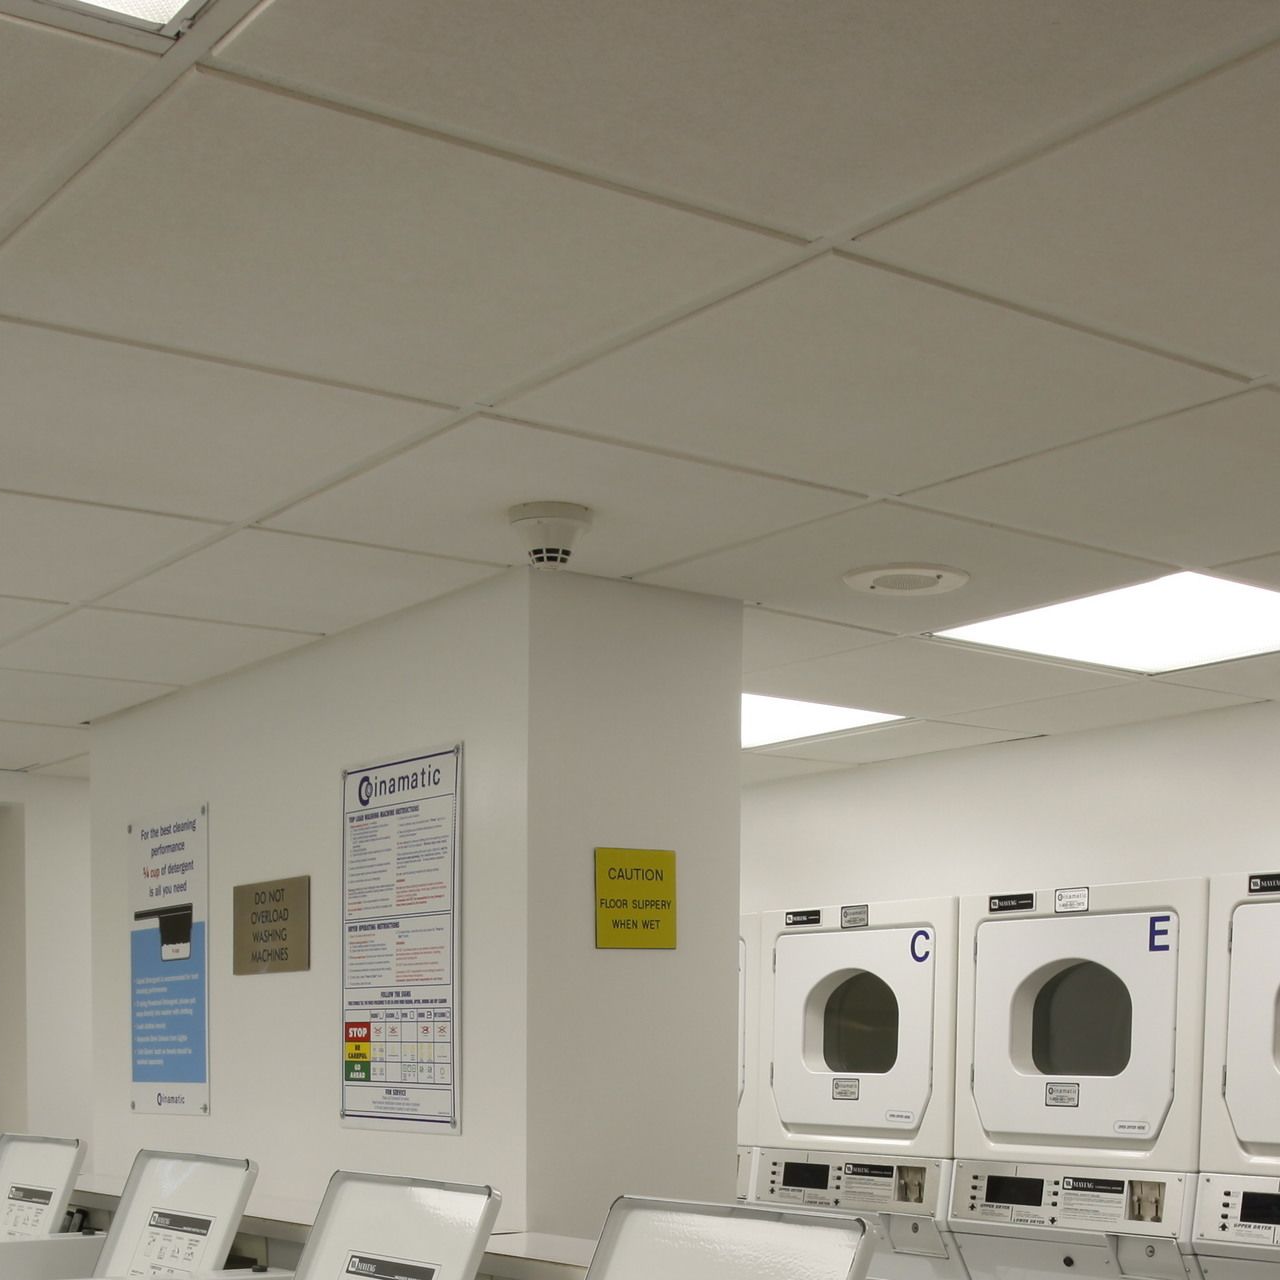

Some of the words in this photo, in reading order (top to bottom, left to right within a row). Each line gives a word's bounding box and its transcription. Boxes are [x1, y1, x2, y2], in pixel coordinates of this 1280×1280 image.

[172, 819, 196, 834] cleaning
[151, 841, 185, 858] performance
[167, 859, 194, 875] detergent
[608, 867, 664, 881] CAUTION
[173, 880, 187, 893] need
[254, 891, 267, 905] DO
[268, 888, 285, 903] NOT
[600, 898, 628, 909] FLOOR
[632, 900, 672, 910] SLIPPERY
[250, 907, 289, 925] OVERLOAD
[612, 919, 638, 929] WHEN
[642, 919, 661, 930] WET
[251, 928, 288, 943] WASHING
[1148, 916, 1171, 951] E
[910, 930, 930, 962] C
[250, 947, 289, 962] MACHINES
[348, 1027, 368, 1038] STOP
